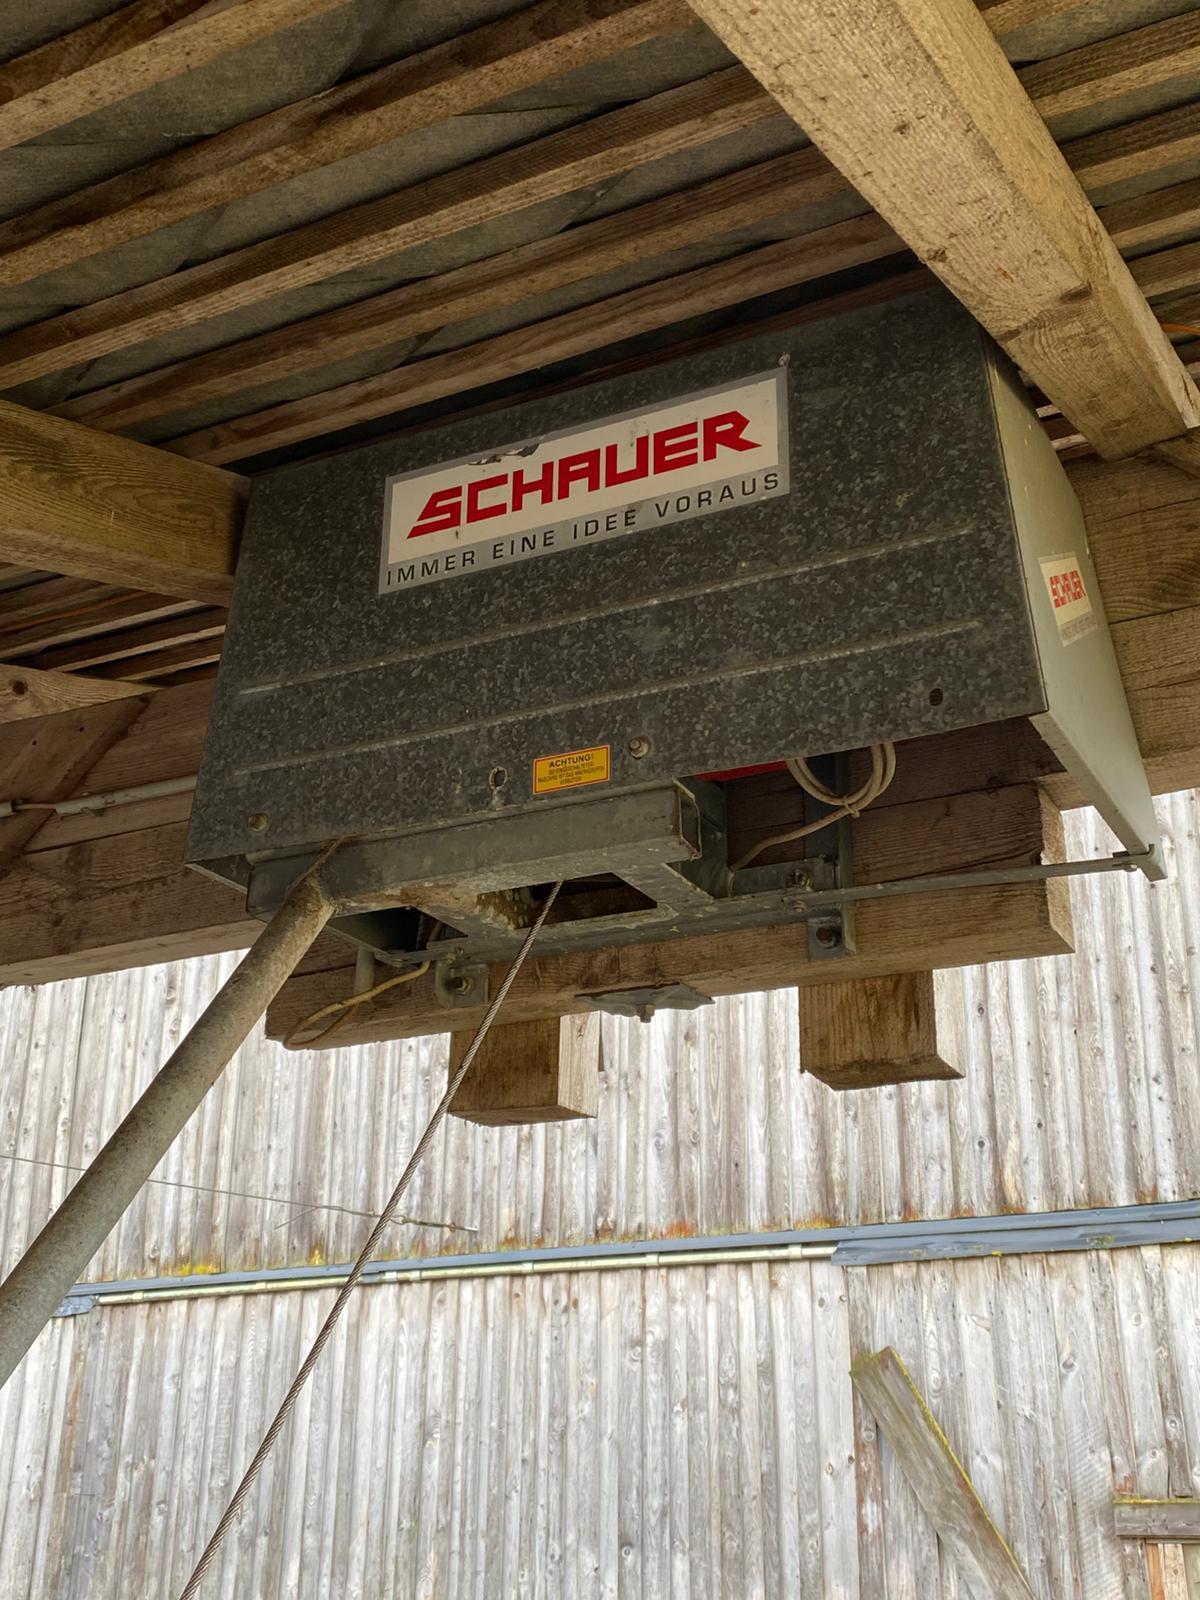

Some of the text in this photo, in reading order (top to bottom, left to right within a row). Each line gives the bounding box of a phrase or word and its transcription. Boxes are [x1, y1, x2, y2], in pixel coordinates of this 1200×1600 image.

[386, 472, 779, 586] IMMER EINE IDEE VORAUS
[406, 410, 763, 539] SCHAUER
[549, 753, 594, 768] ACHTUNG!
